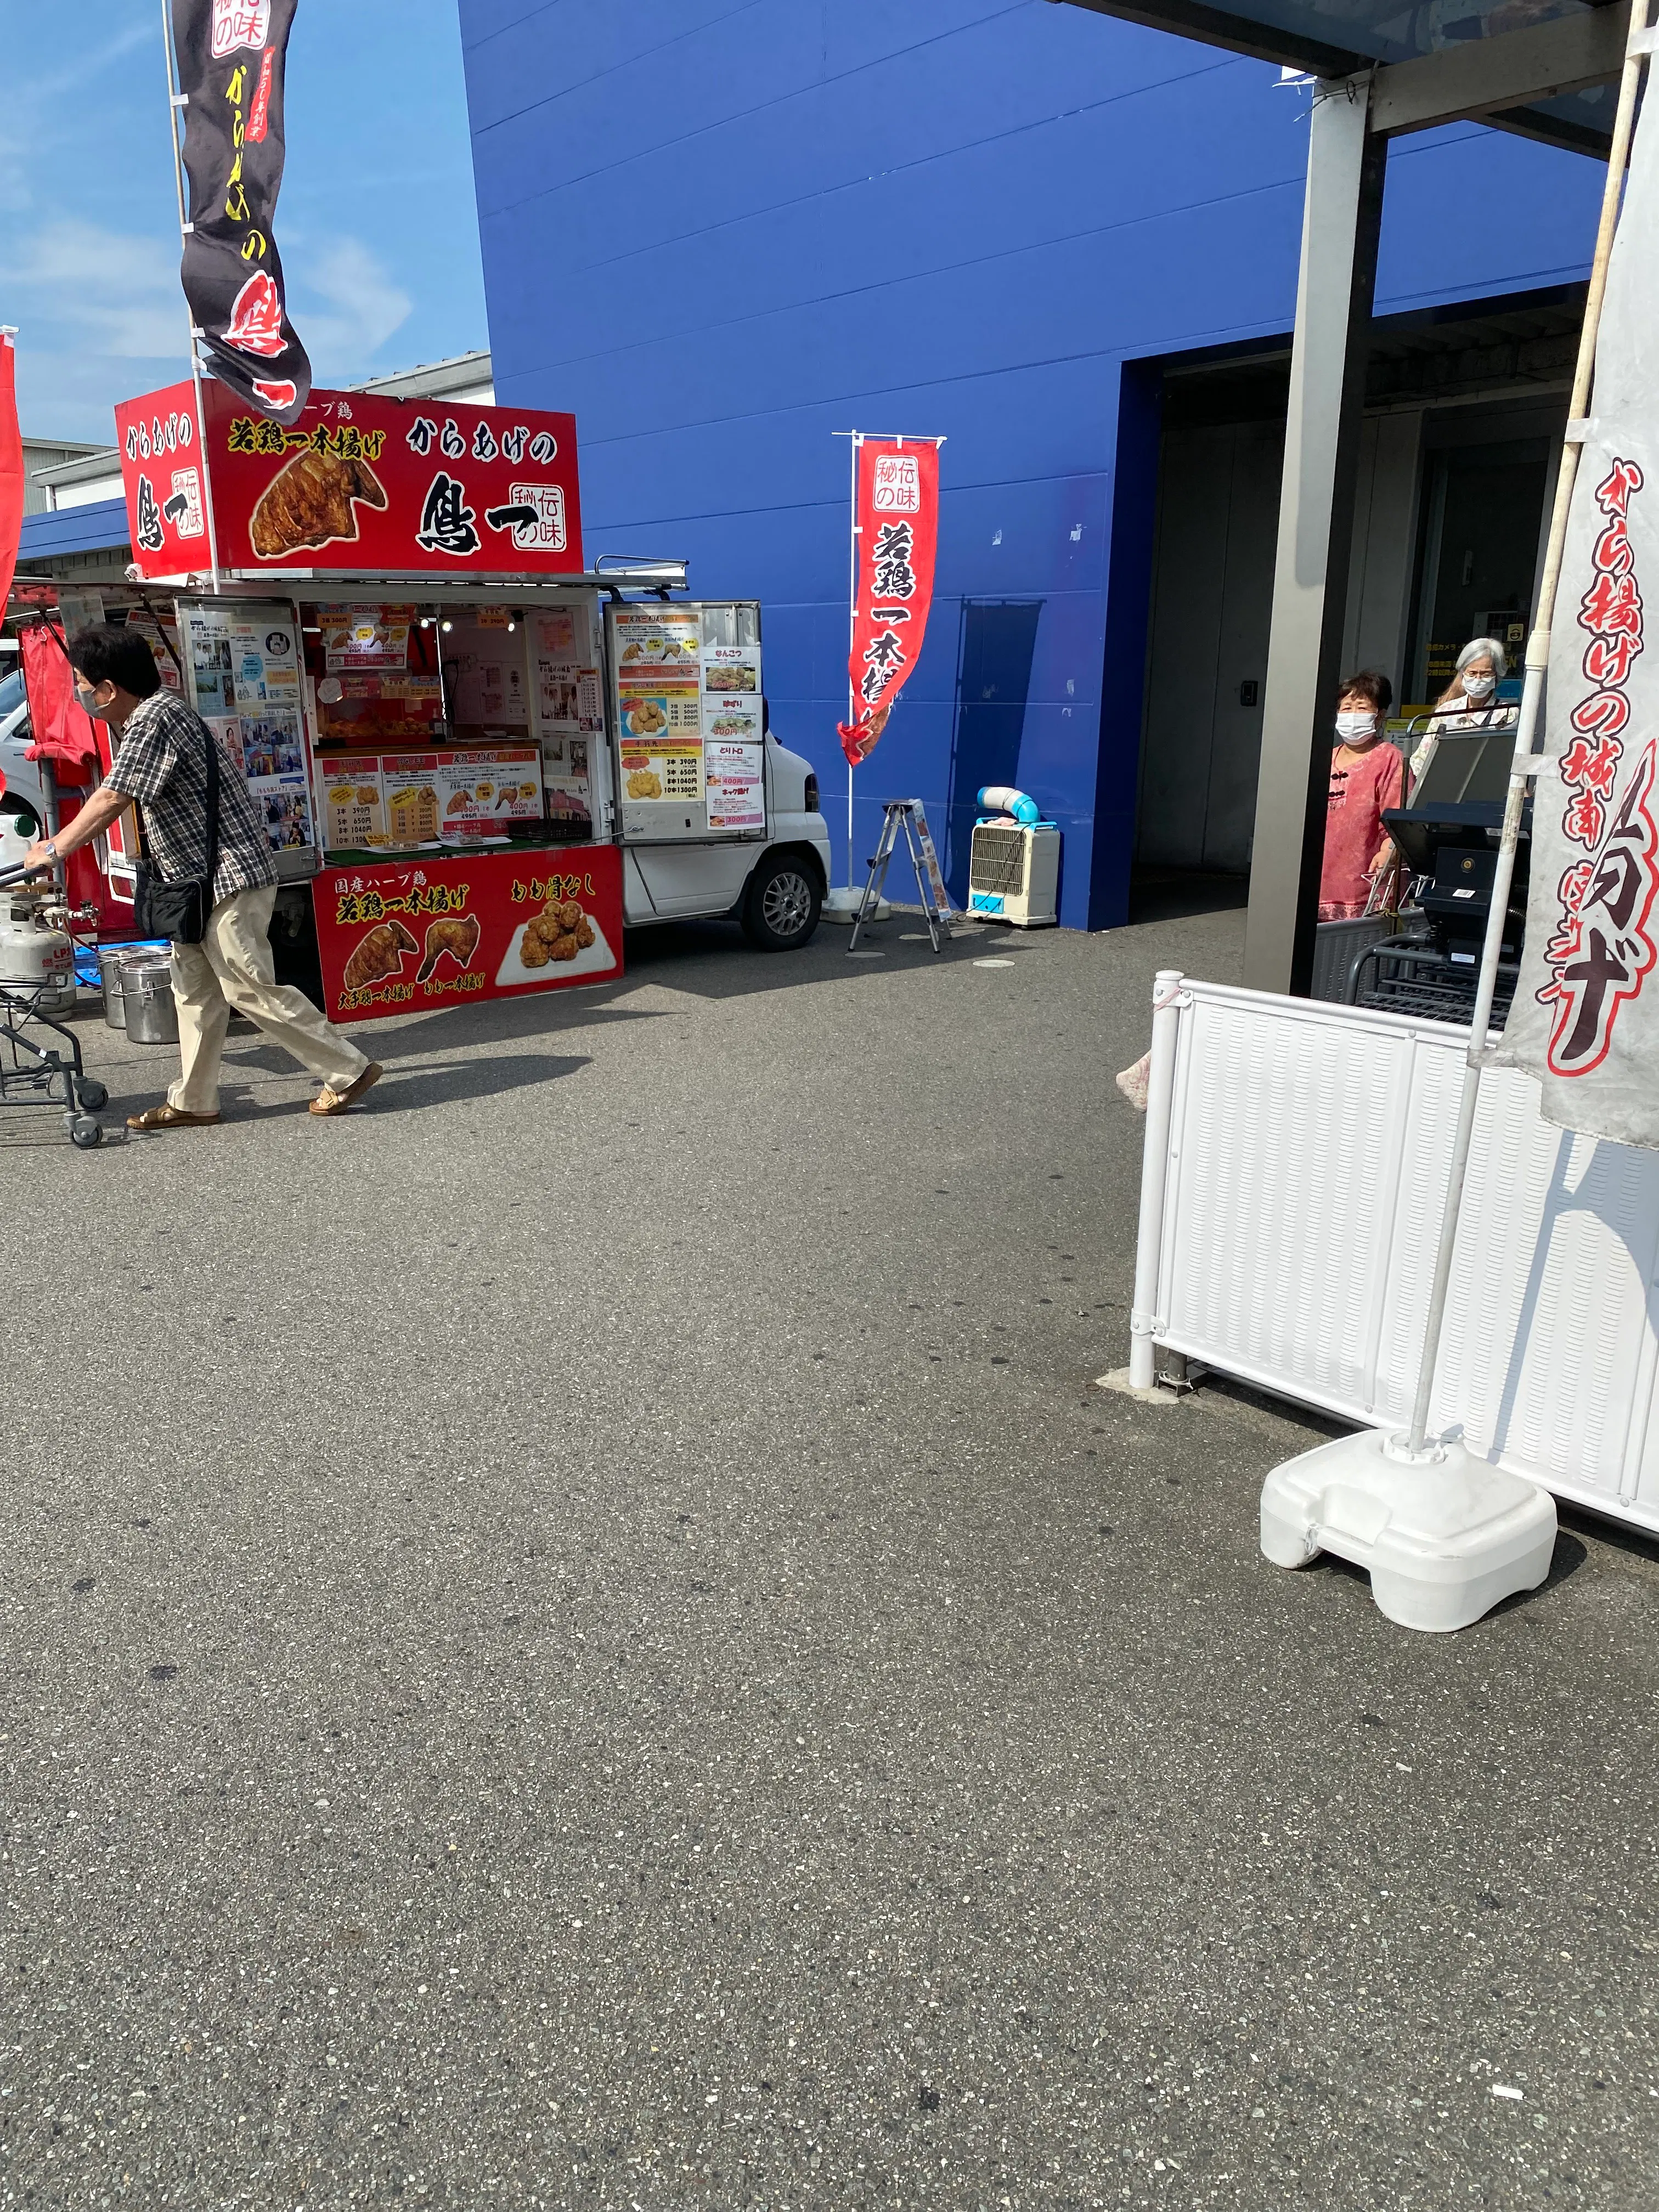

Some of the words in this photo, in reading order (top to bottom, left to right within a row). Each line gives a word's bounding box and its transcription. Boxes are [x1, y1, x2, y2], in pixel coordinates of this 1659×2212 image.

[126, 412, 192, 461] からあげの
[227, 416, 386, 461] 若鶏一本揚げ
[407, 416, 558, 465] からあげの
[877, 461, 915, 485] 秘伝
[138, 473, 188, 551] 鳥一
[415, 471, 540, 556] 鳥一
[877, 487, 916, 511] の味
[335, 870, 427, 894] 国産ハーブ鶏
[336, 884, 470, 924] 若鶏一本揚げ
[337, 983, 415, 1010] 大手羽一本揚げ
